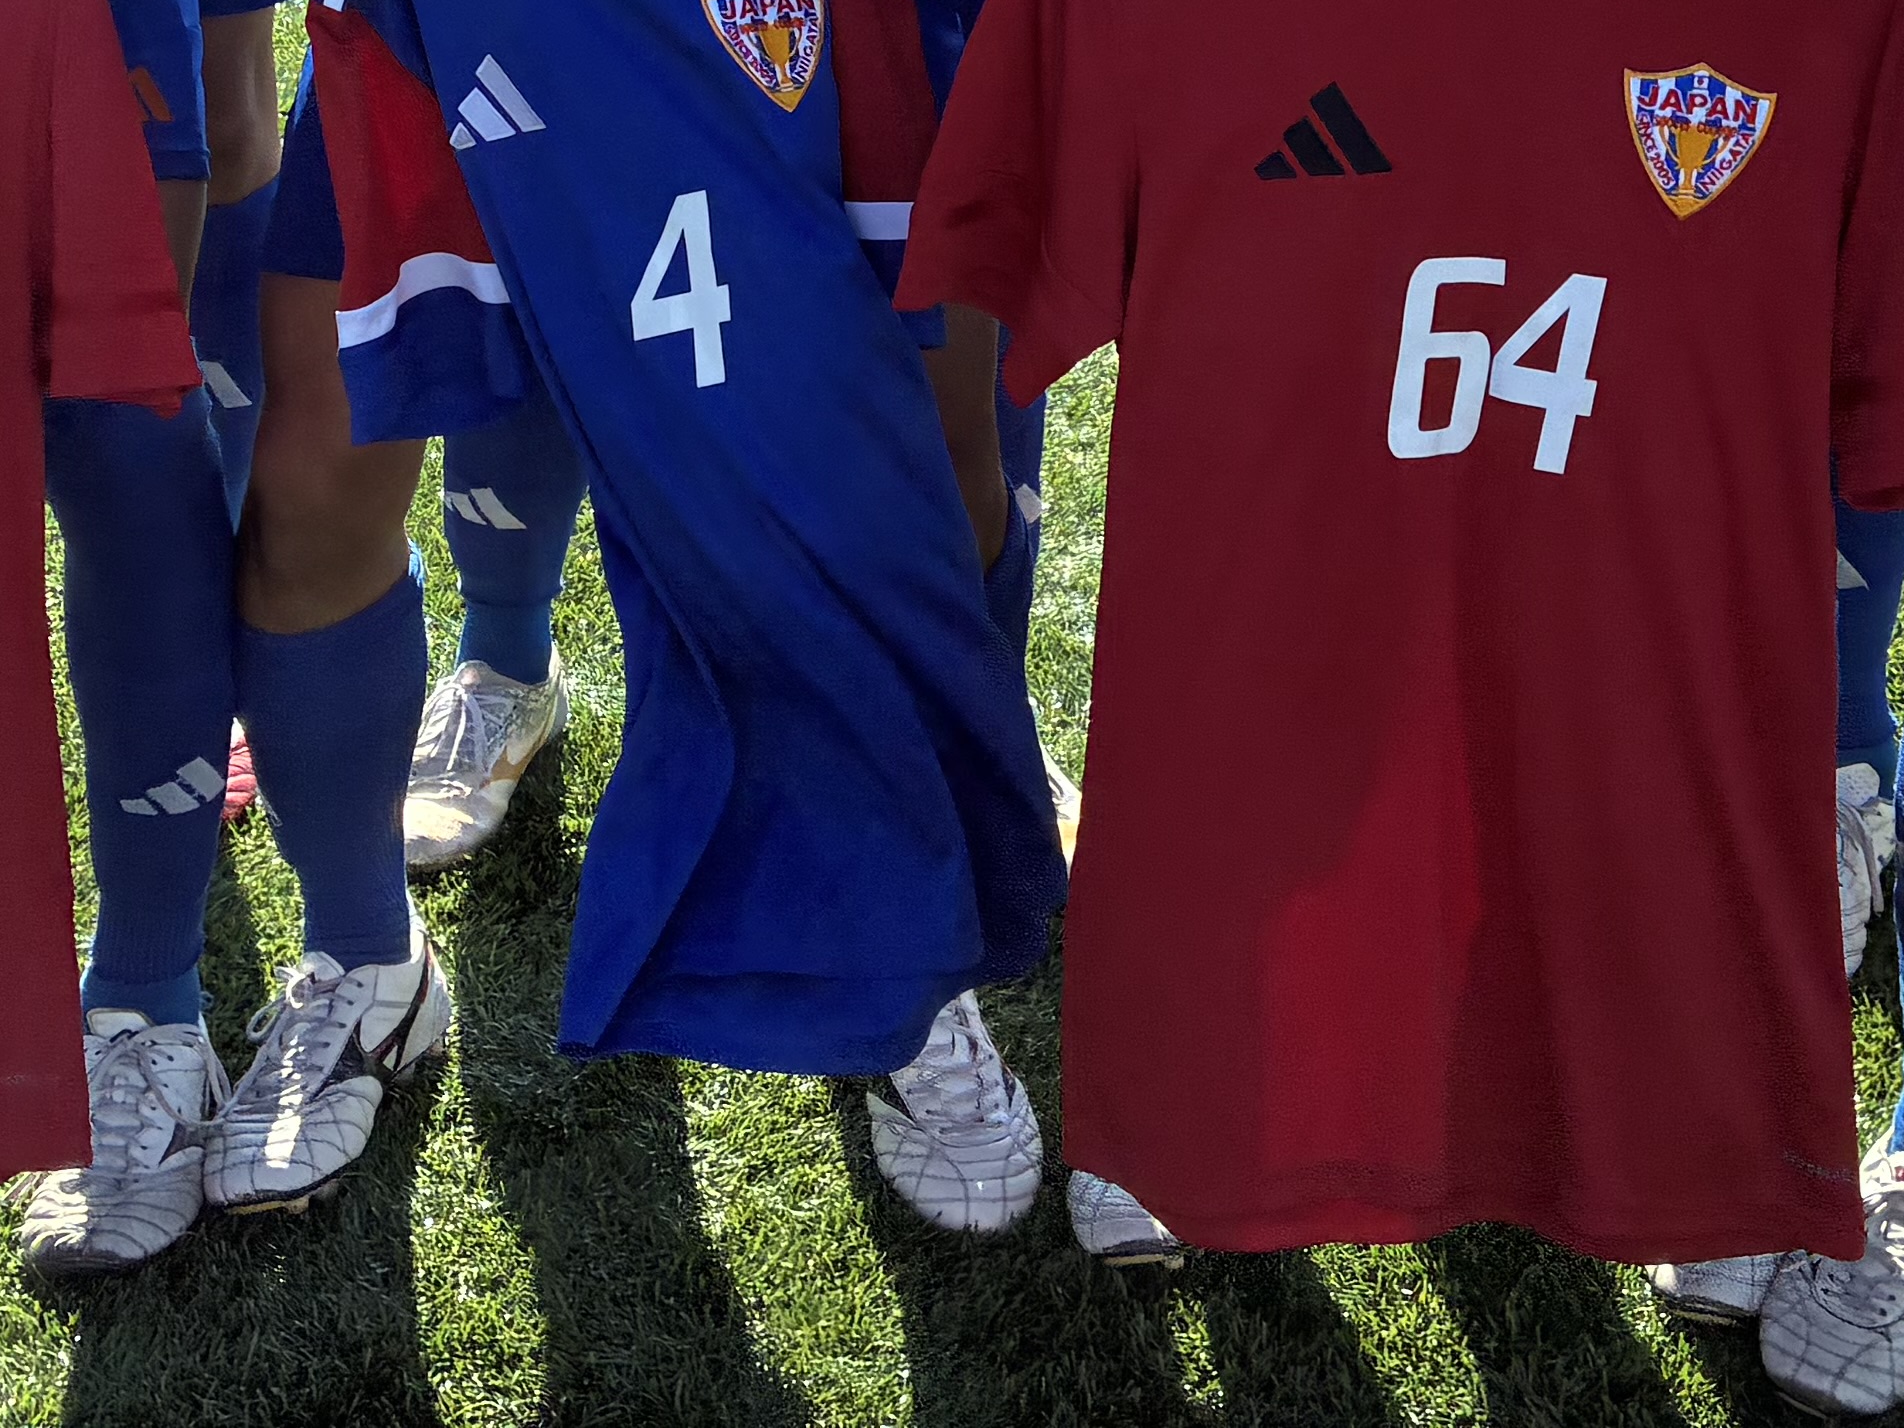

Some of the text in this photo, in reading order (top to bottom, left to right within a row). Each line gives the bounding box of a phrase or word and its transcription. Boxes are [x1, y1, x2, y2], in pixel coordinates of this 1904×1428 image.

[1637, 85, 1758, 125] JAPAN
[1650, 152, 1675, 186] 2005
[1700, 133, 1755, 192] NIIGATA
[631, 190, 732, 388] 4
[1387, 257, 1608, 475] 64
